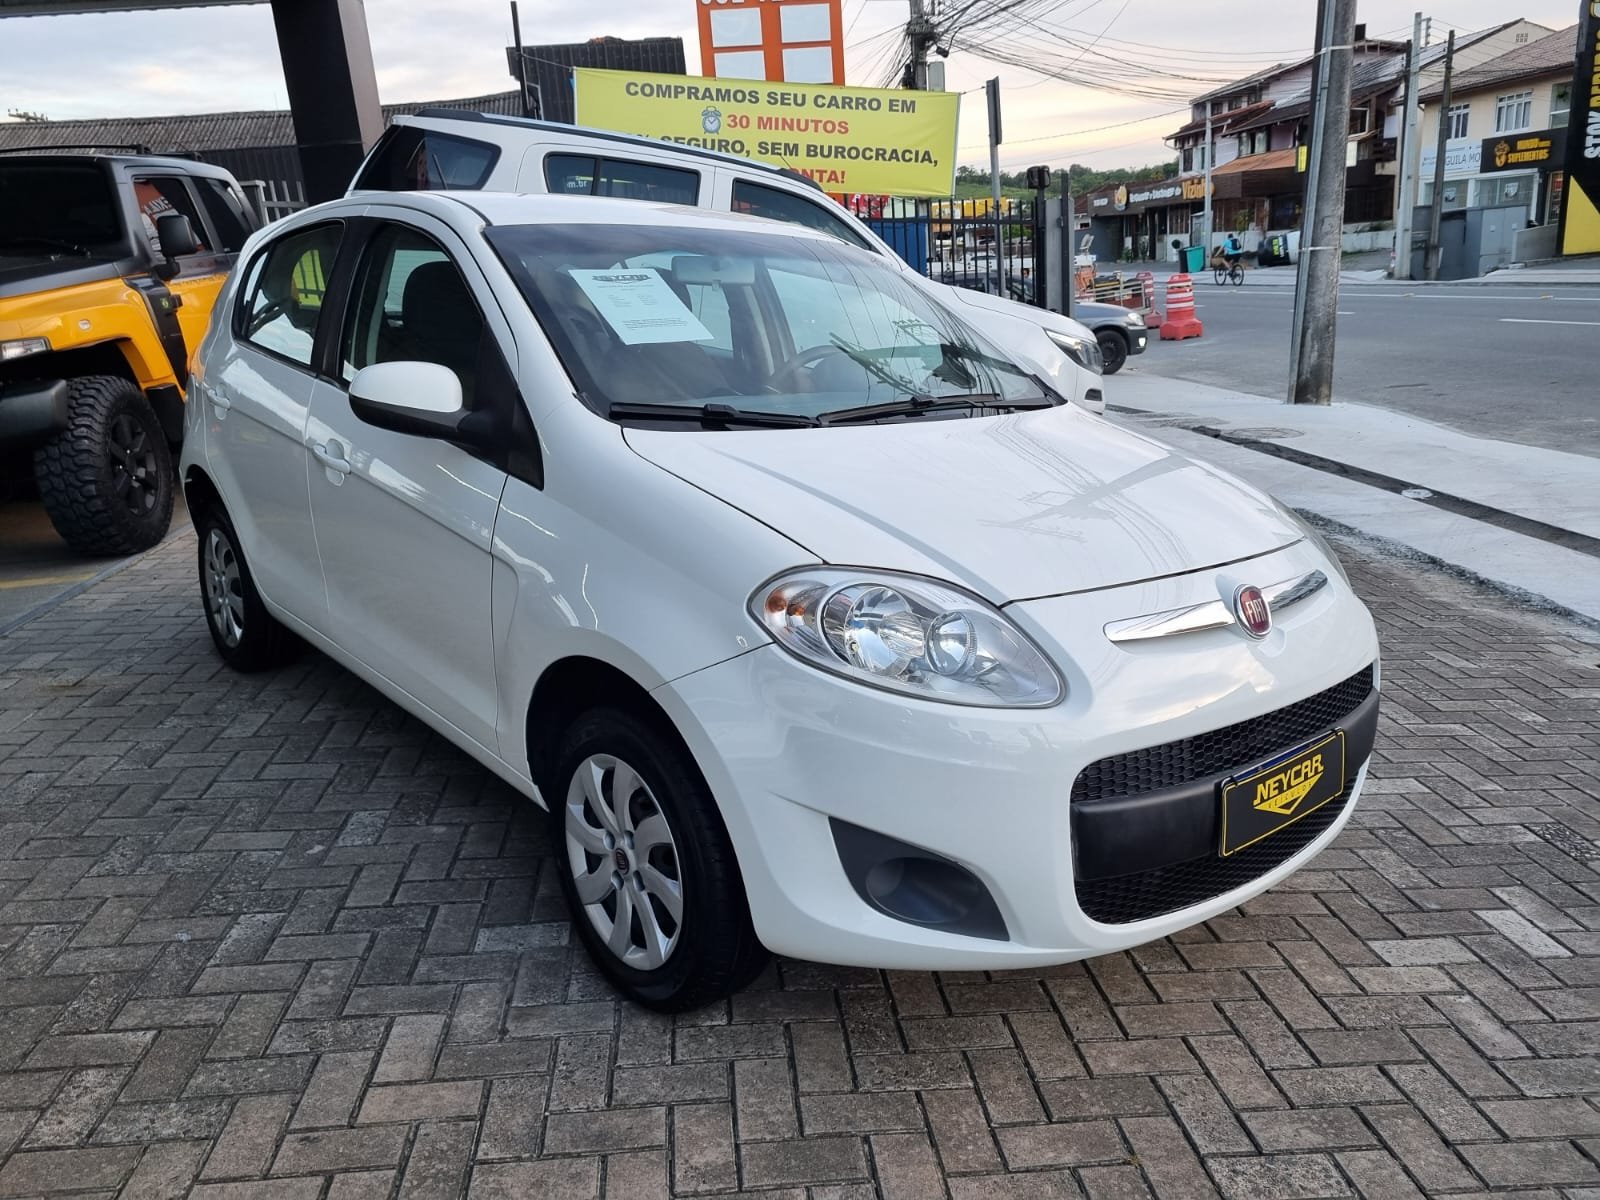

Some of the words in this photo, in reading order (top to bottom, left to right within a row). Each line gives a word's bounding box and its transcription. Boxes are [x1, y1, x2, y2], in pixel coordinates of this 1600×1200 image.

[625, 82, 760, 104] COMPRAMOS
[766, 90, 806, 107] SEU
[813, 94, 882, 111] CARRO
[888, 99, 916, 113] EM
[727, 114, 750, 129] 30
[757, 116, 849, 135] MINUTOS
[757, 141, 799, 157] SEM
[806, 144, 938, 167] BUROCRACIA,
[1245, 598, 1267, 625] FIAT
[1253, 754, 1324, 806] NEYCAR
